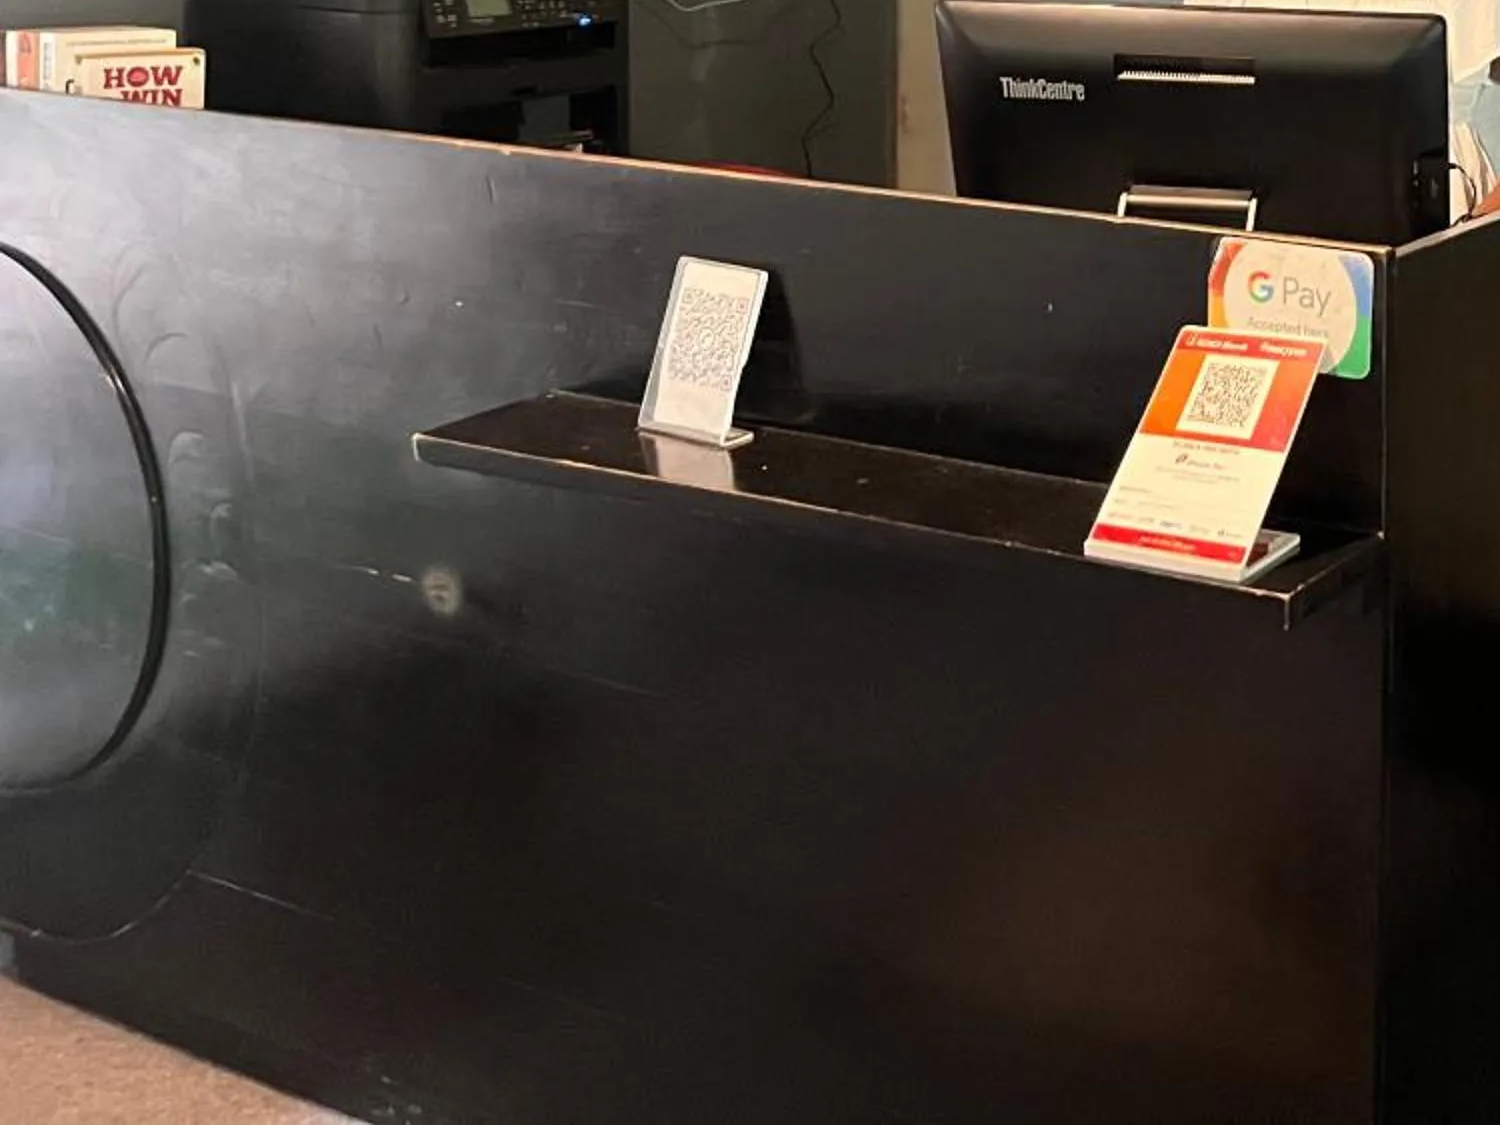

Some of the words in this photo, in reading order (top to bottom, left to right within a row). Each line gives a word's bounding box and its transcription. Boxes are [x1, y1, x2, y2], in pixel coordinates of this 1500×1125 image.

[103, 65, 183, 89] HOW
[999, 76, 1085, 101] ThinkCentre
[120, 89, 182, 106] WIN
[1247, 270, 1275, 303] G
[1283, 277, 1332, 318] Pay
